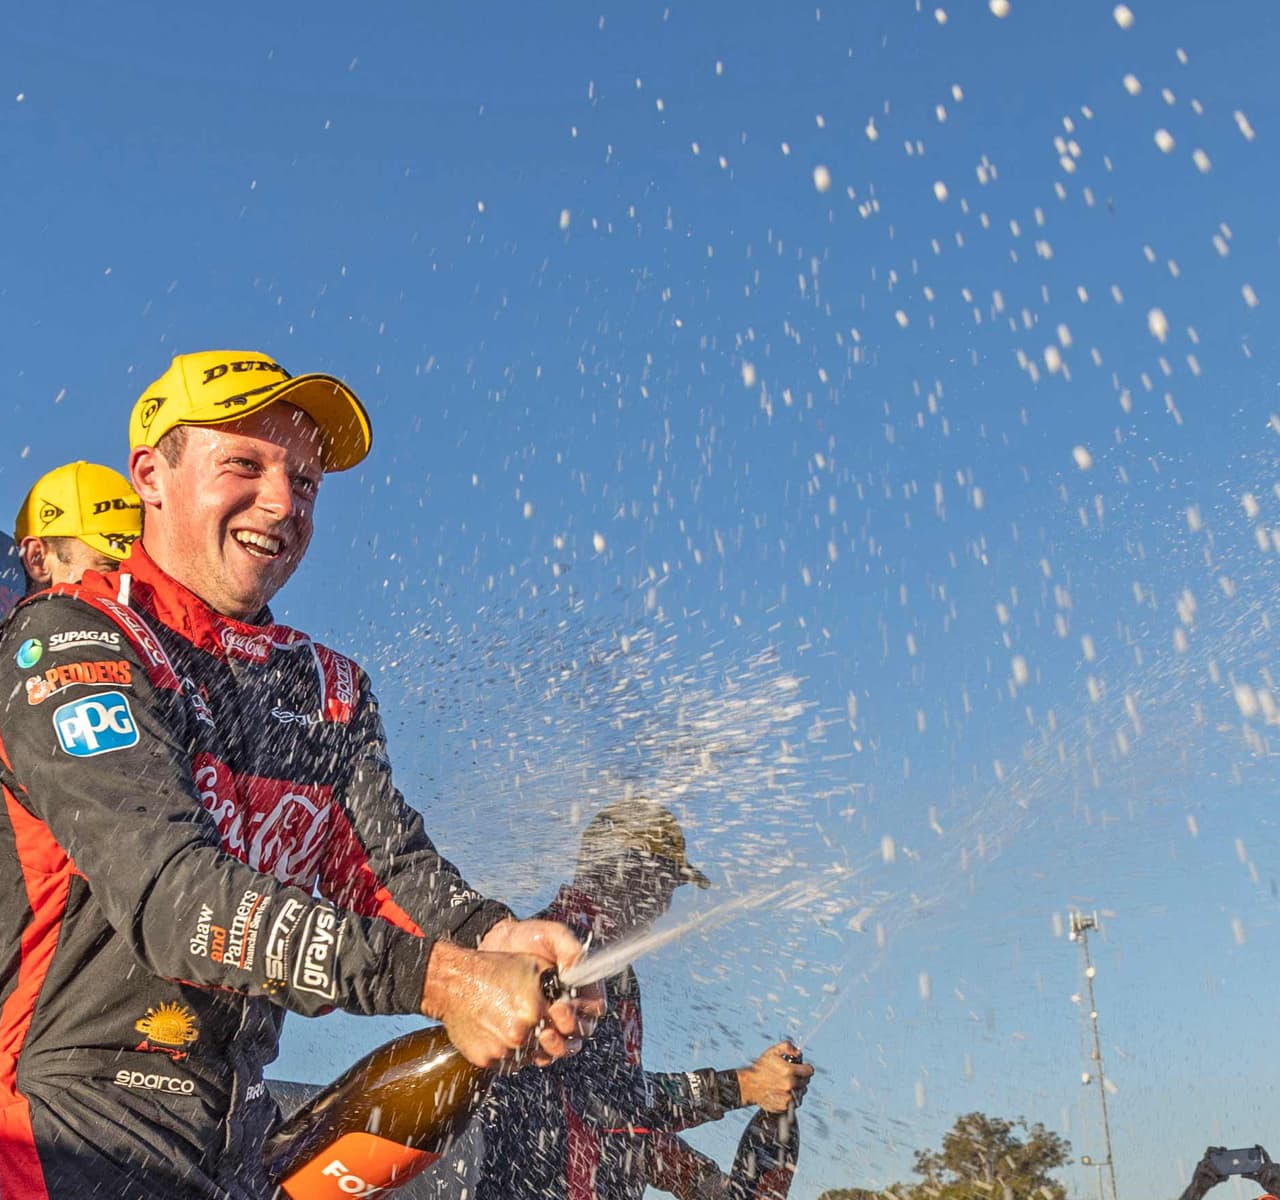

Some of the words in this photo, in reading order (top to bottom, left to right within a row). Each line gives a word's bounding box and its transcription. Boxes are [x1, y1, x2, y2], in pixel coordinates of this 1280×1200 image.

[202, 361, 285, 385] DUN
[49, 630, 121, 646] SUPAGAS
[45, 660, 133, 691] PEDDERS
[59, 702, 134, 750] PPG
[190, 903, 214, 957] Shaw
[210, 925, 226, 963] and
[223, 890, 259, 968] Partners
[303, 910, 336, 988] grays
[114, 1069, 195, 1096] sparco
